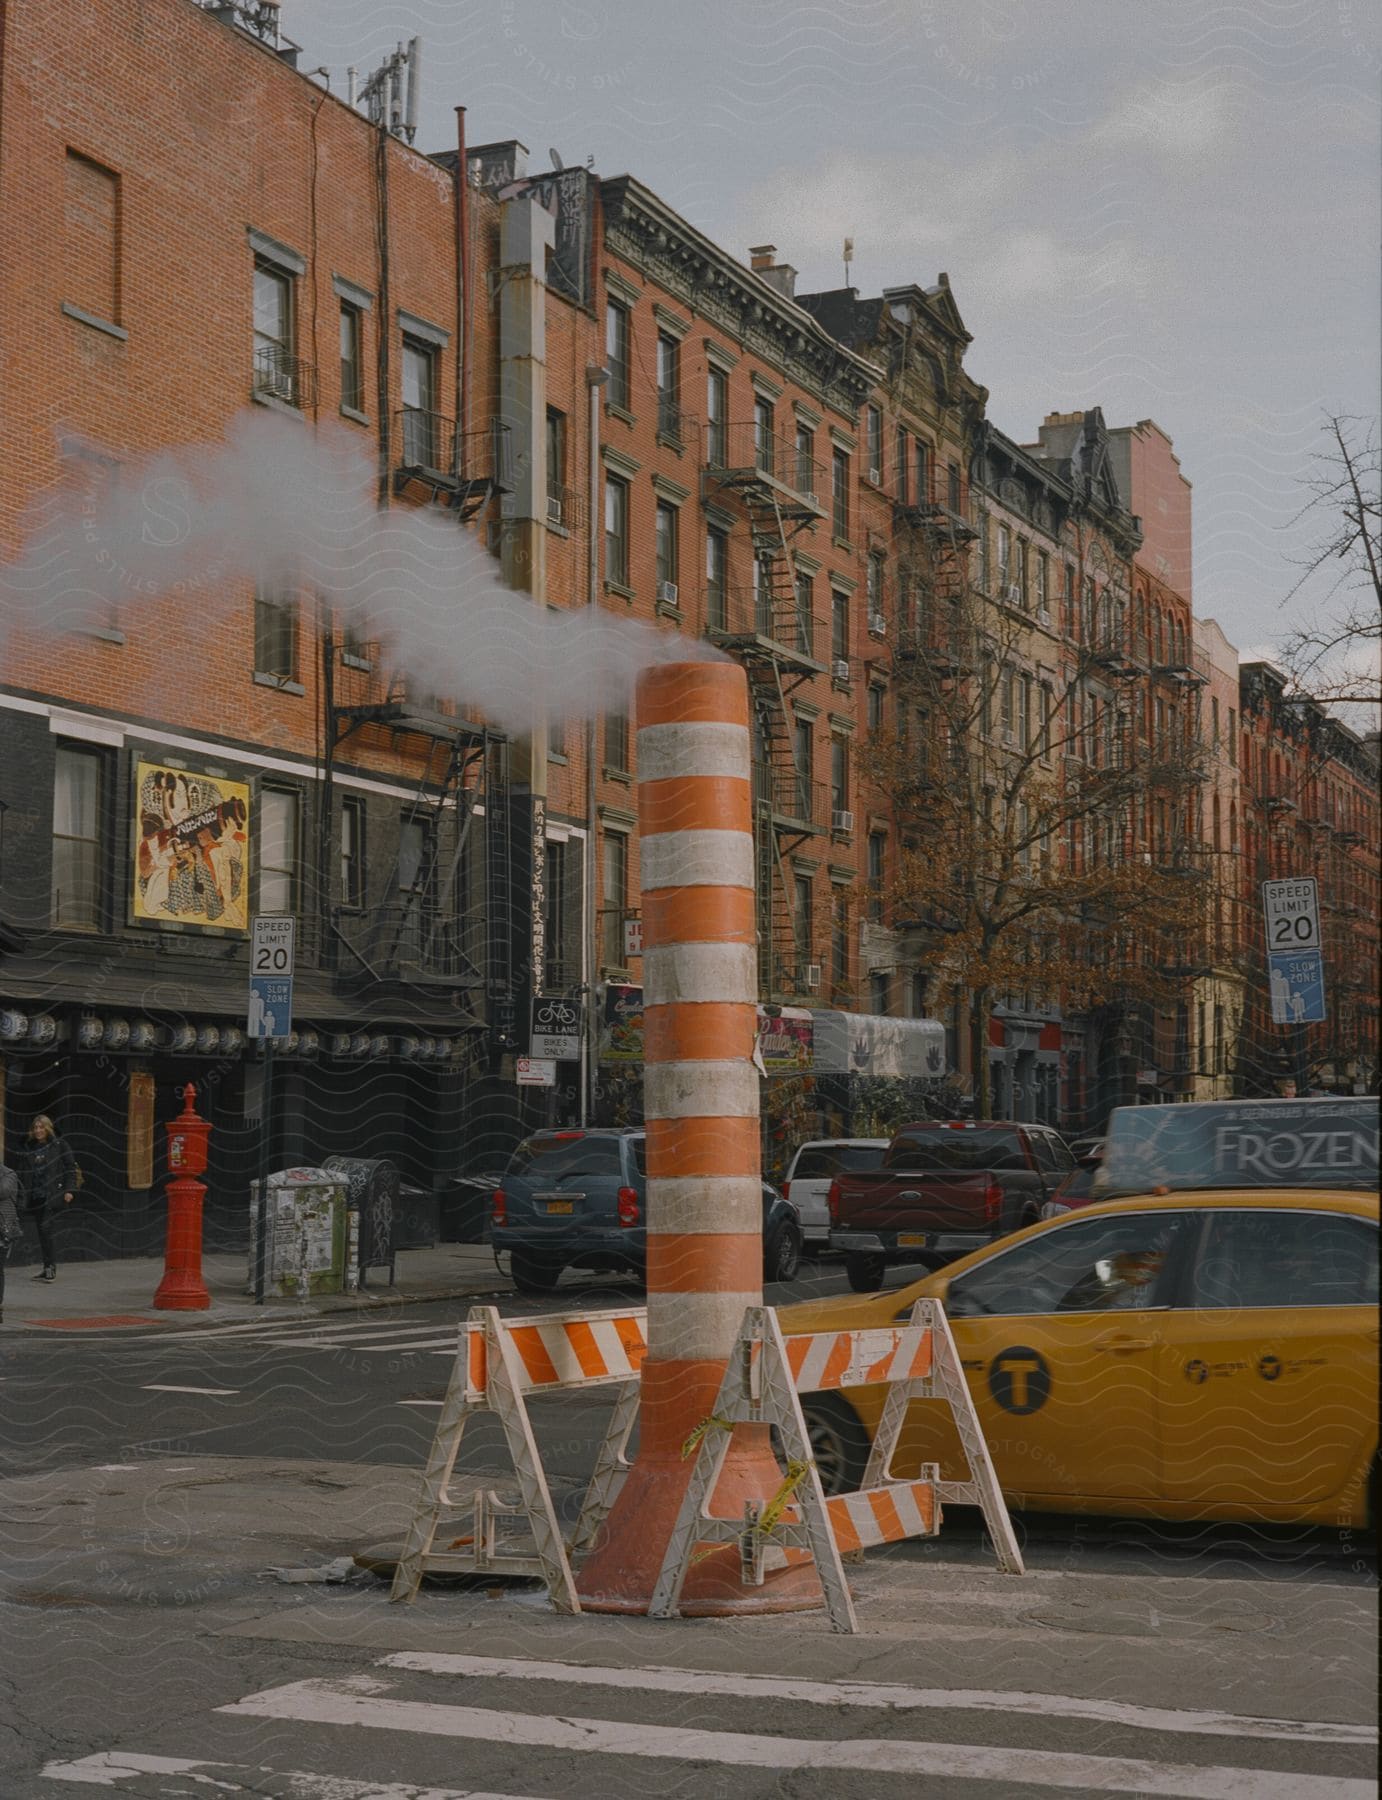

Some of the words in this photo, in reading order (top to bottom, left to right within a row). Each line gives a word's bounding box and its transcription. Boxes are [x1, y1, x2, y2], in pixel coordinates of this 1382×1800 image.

[1269, 885, 1312, 900] SPEED
[1273, 900, 1310, 914] LIMIT
[256, 922, 291, 932] SPEED
[1275, 915, 1313, 943] 20
[259, 935, 288, 945] LIMIT
[256, 947, 288, 970] 20
[1289, 960, 1316, 973] SLOW
[1290, 971, 1318, 984] ZONE
[266, 984, 289, 995] SLOW
[266, 994, 289, 1004] ZONE
[534, 1024, 553, 1034] BIKE
[556, 1025, 577, 1035] LANE
[544, 1038, 567, 1047] BIKES
[544, 1048, 566, 1057] ONLY
[1216, 1126, 1380, 1179] FROZEN
[1000, 1359, 1039, 1407] T
